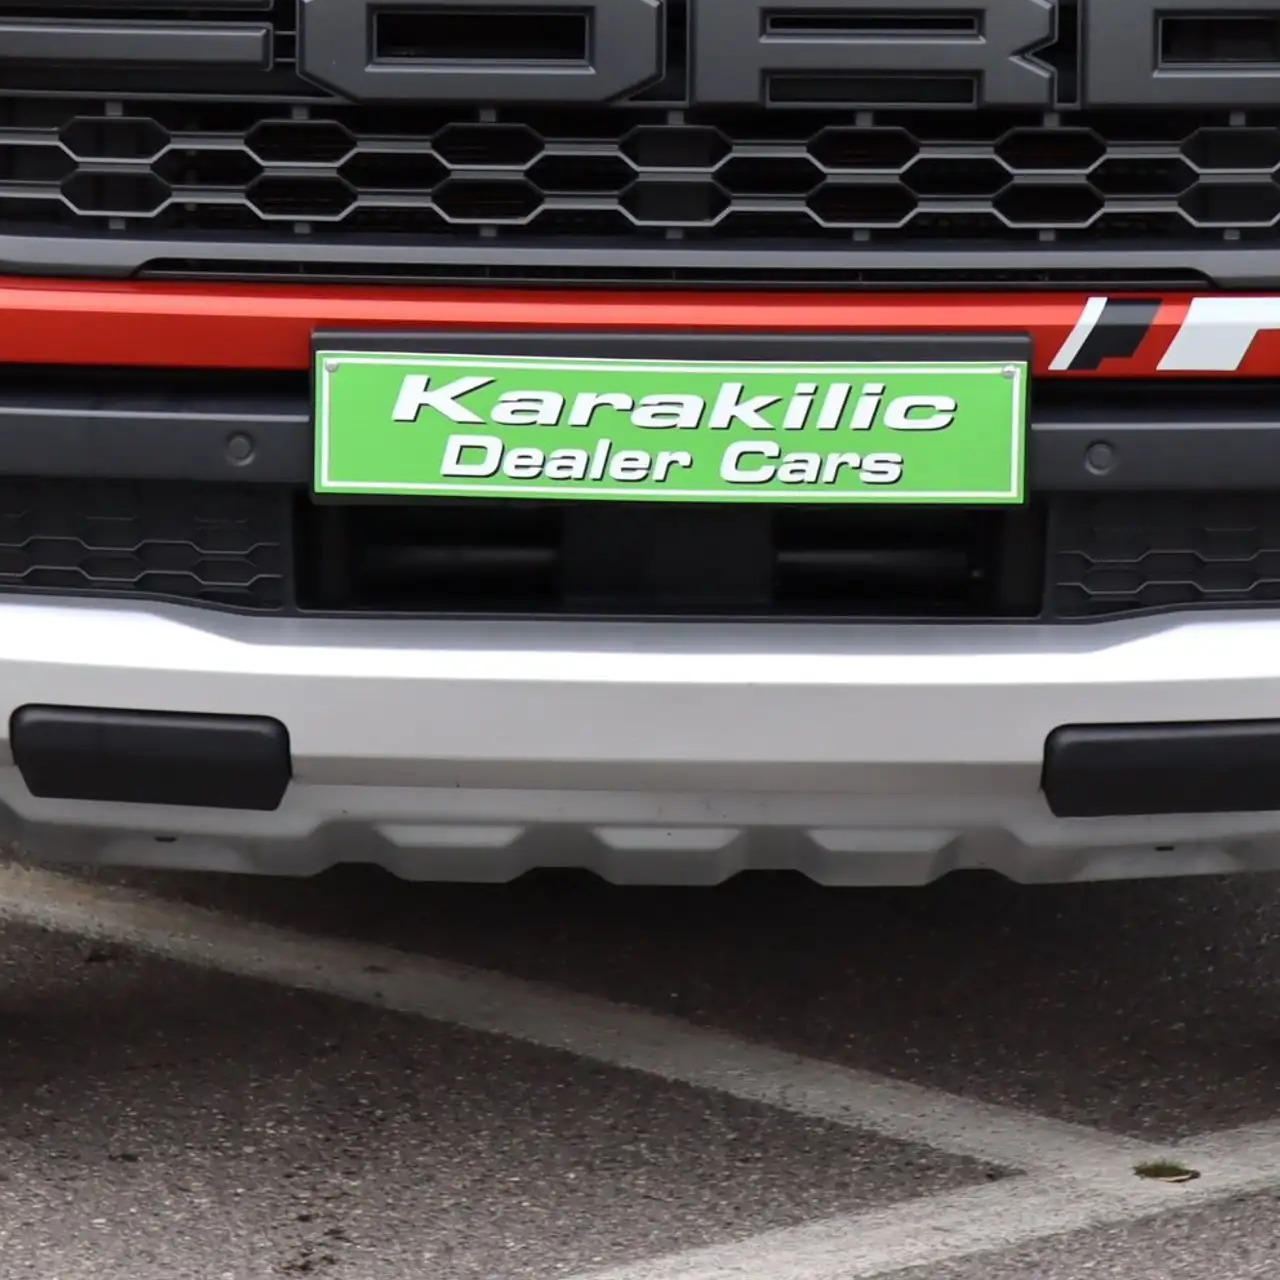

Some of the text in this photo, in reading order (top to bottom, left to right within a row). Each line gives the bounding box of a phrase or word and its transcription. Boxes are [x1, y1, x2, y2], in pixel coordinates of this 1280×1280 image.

[391, 373, 958, 433] Karakilic
[439, 433, 905, 486] Dealer Cars
